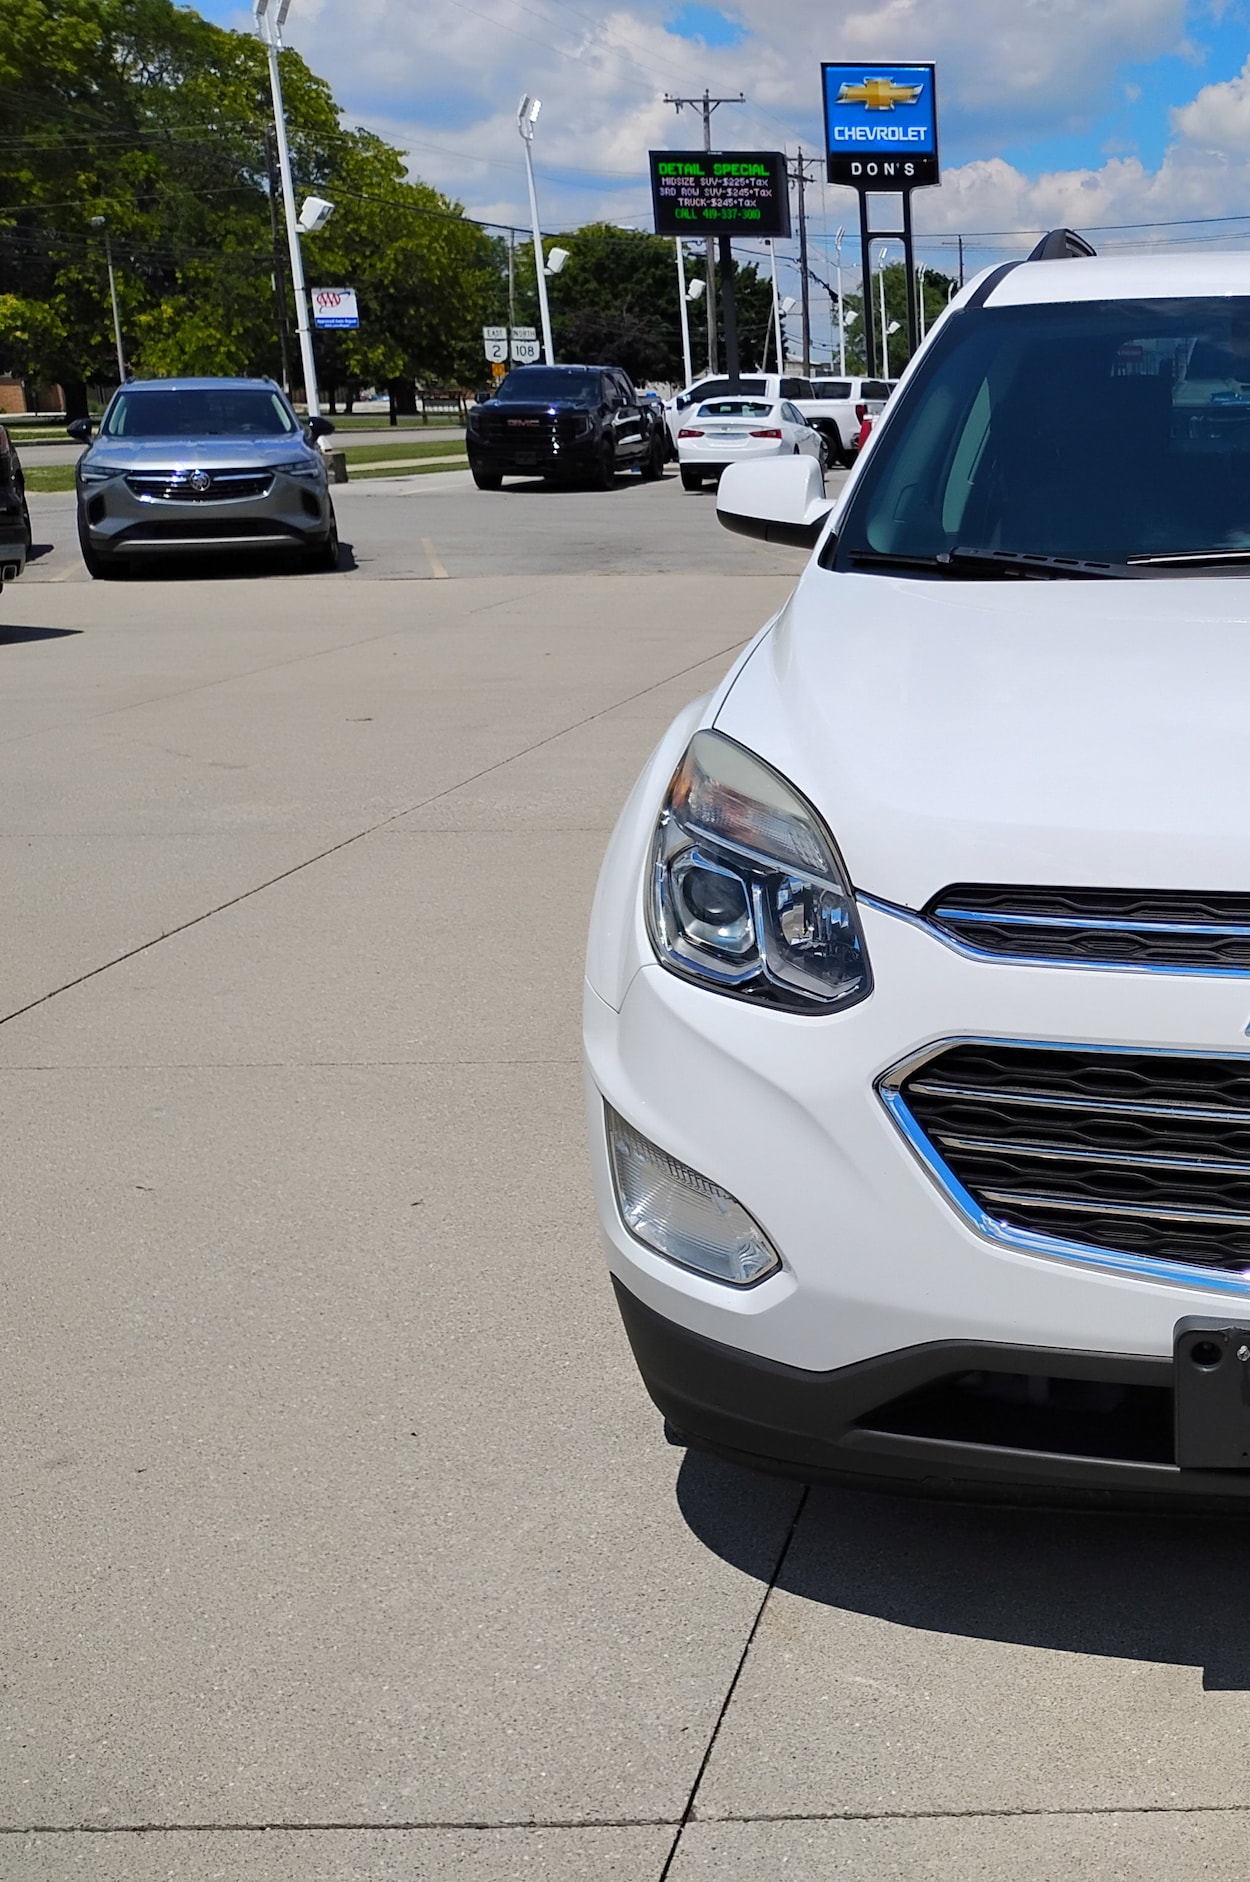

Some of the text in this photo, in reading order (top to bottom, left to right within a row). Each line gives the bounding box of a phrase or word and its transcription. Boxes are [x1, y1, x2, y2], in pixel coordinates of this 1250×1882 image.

[834, 126, 928, 141] CHEVROLET
[659, 163, 770, 176] DETAIL SPECIAL
[851, 162, 915, 176] DON'S
[661, 177, 695, 186] MIDSIZE
[659, 187, 677, 196] 3RD
[681, 187, 700, 196] ROW
[675, 208, 697, 219] CALL
[487, 329, 503, 337] EAST
[492, 345, 501, 357] 2
[516, 345, 534, 357] 108
[507, 419, 540, 427] GMC
